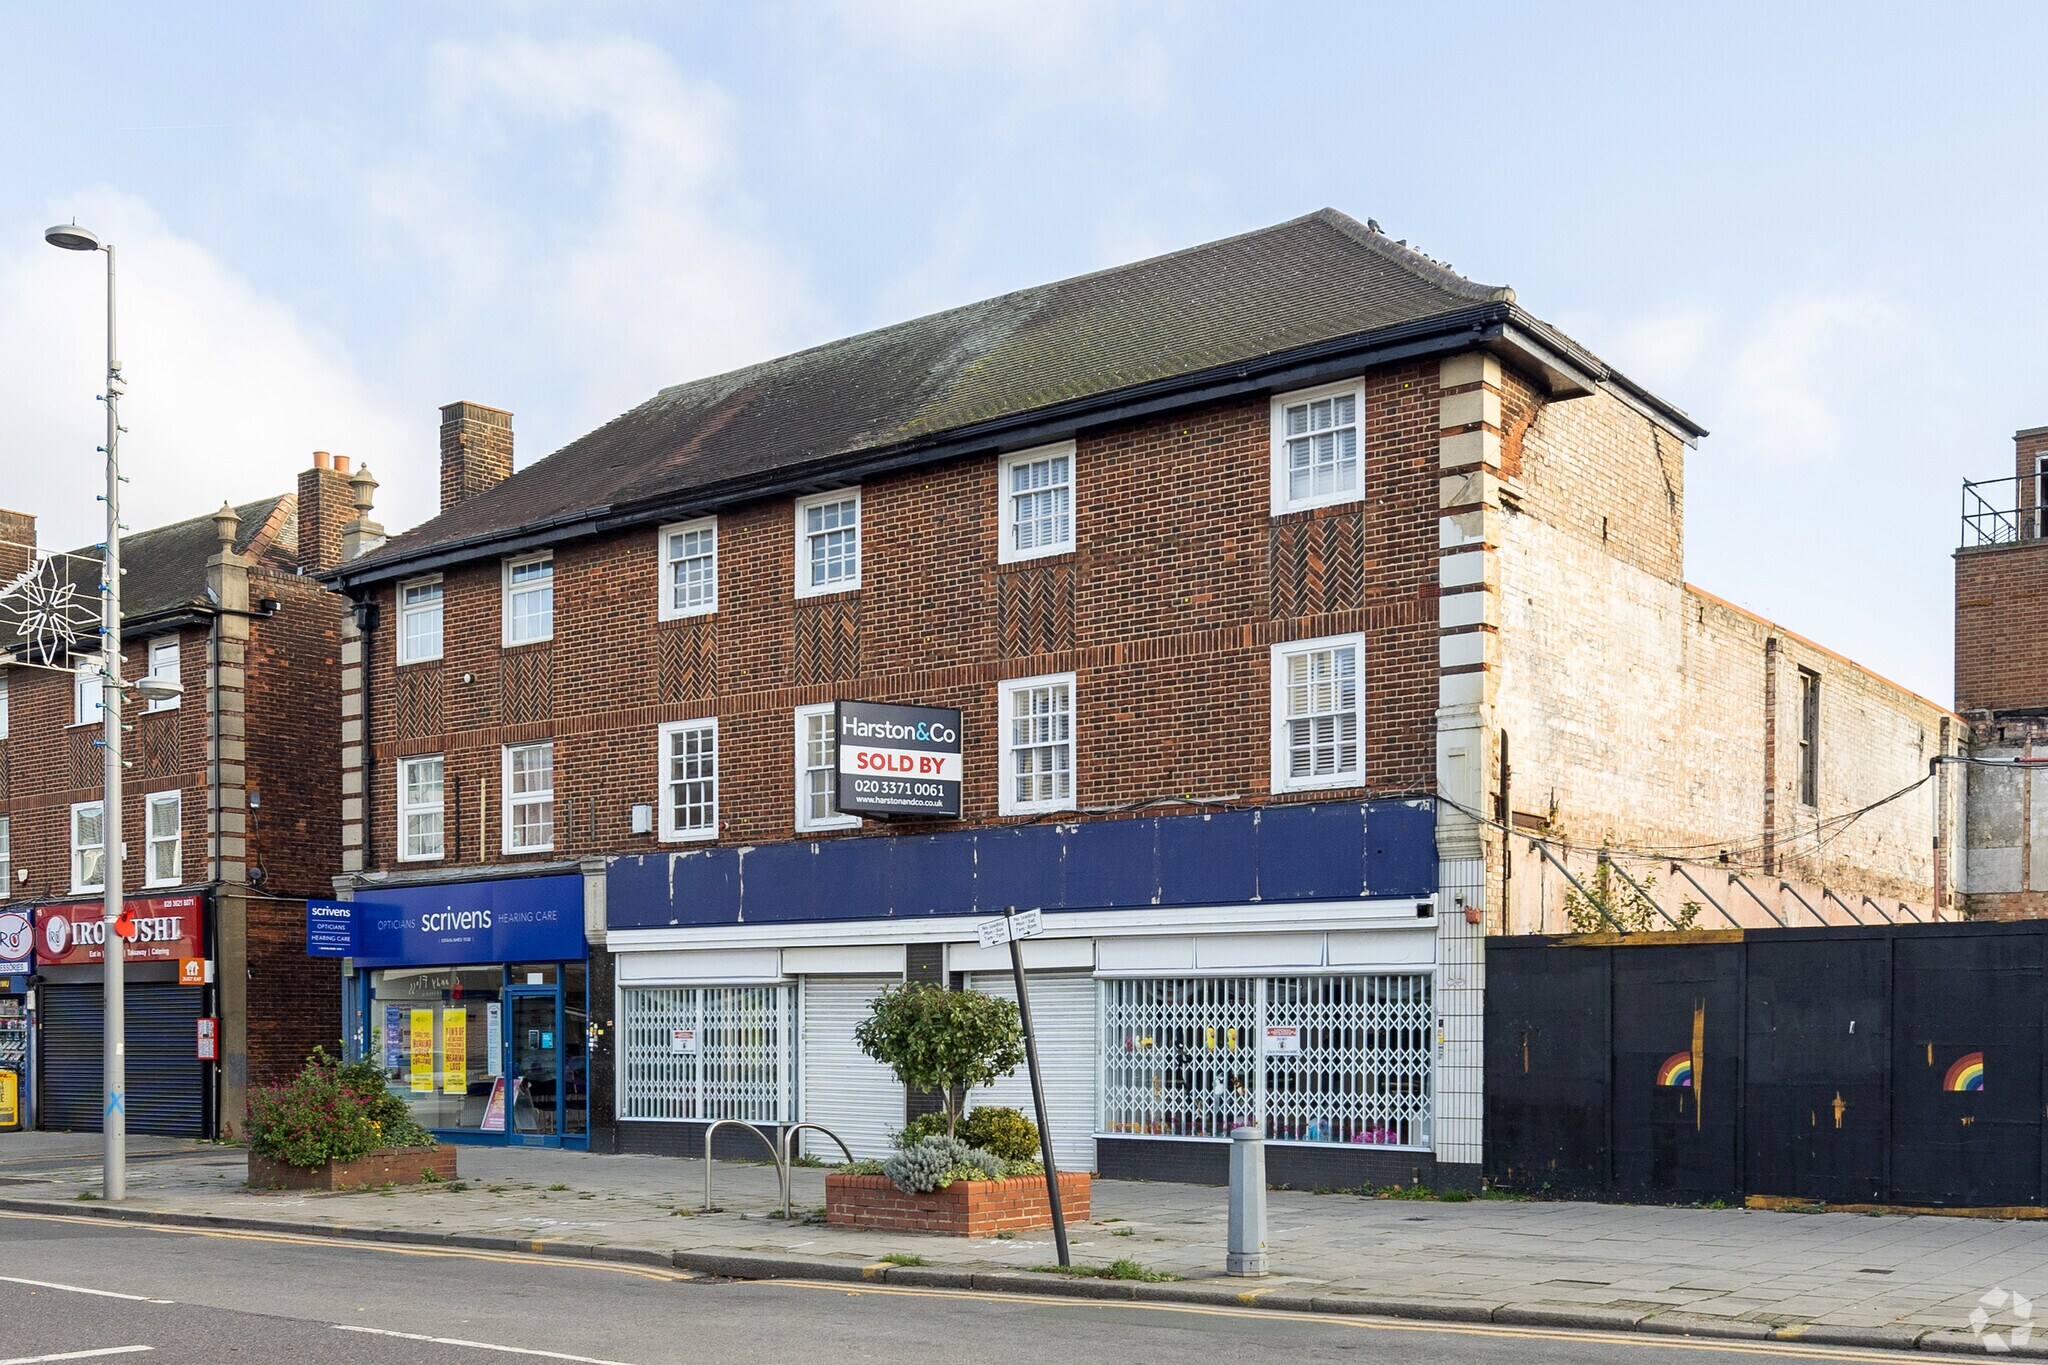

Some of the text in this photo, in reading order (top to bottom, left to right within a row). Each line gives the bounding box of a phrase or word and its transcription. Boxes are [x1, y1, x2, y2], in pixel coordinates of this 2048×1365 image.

[843, 716, 956, 743] Harston&Co
[857, 752, 946, 775] SOLD BY
[855, 780, 944, 796] 020 3371 0061
[856, 796, 944, 807] www.harstonandco.co.uk
[312, 906, 351, 917] scrivens
[378, 906, 557, 932] OPTICIANS scrivens HEARING CARE
